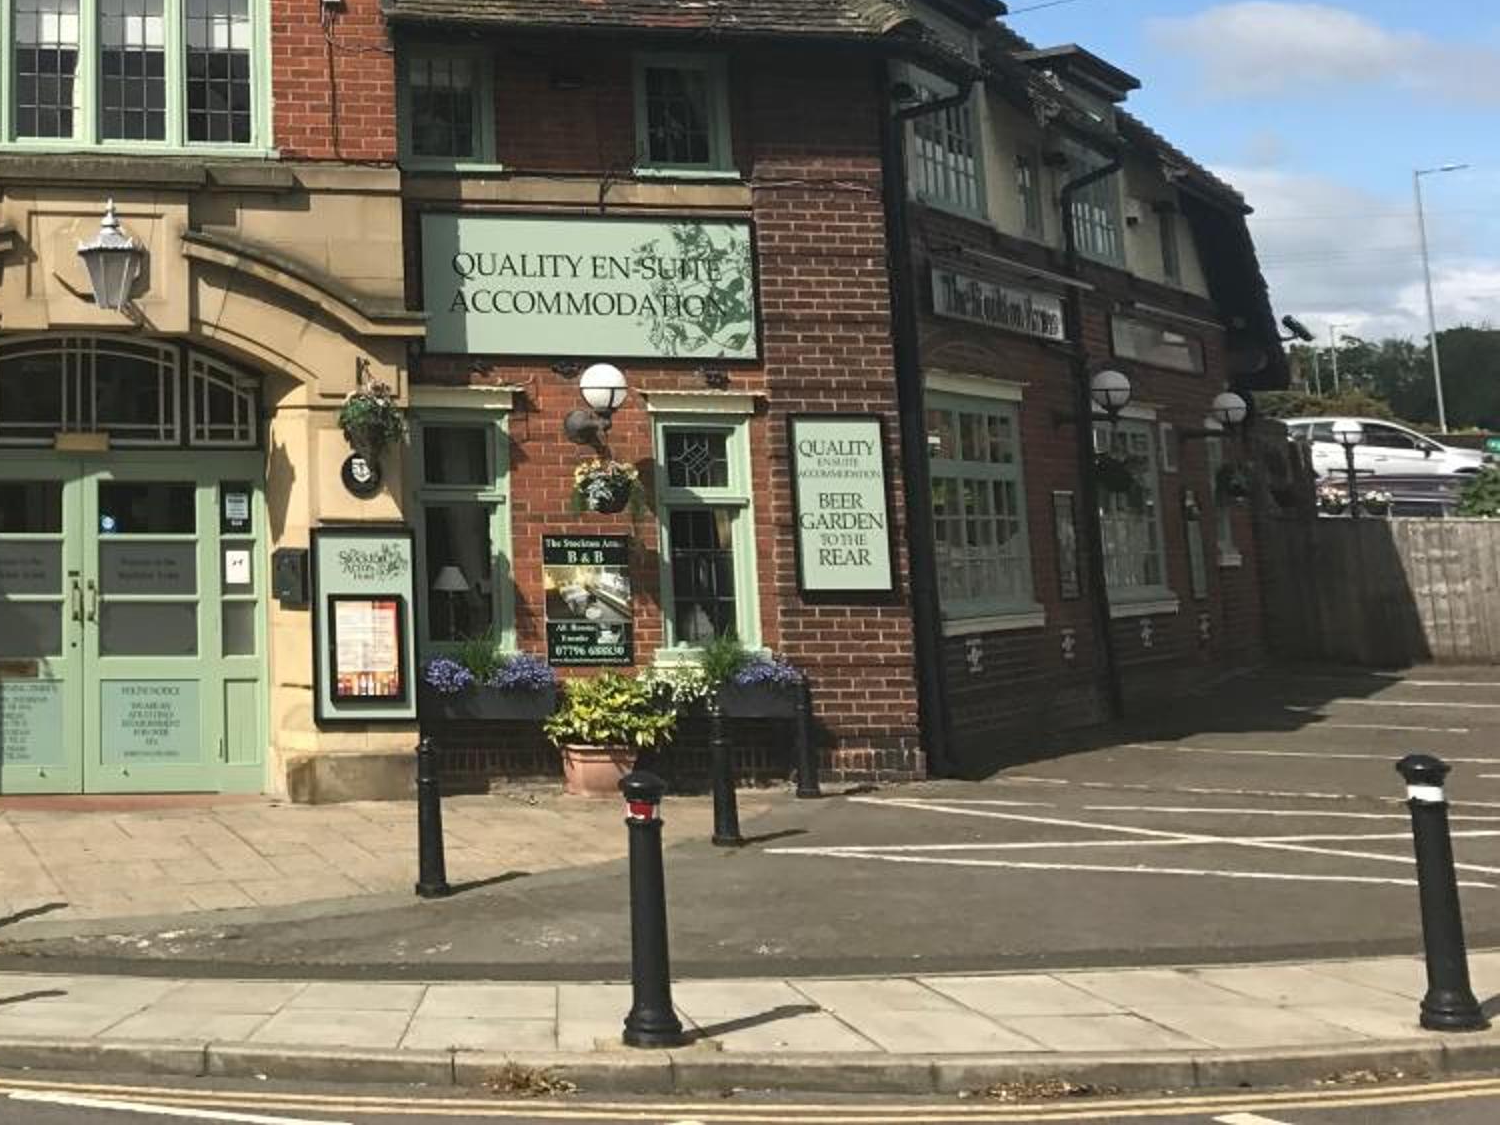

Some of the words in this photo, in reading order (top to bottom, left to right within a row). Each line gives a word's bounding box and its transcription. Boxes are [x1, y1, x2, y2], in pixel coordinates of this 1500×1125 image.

[453, 251, 583, 280] QUALITY
[592, 255, 723, 282] EN-SUITE
[449, 289, 729, 318] ACCOMMODATION
[798, 439, 875, 458] QUALITY
[818, 492, 864, 509] BEER
[799, 512, 885, 530] GARDEN
[545, 538, 561, 548] The
[563, 538, 600, 548] Stockton
[820, 533, 838, 546] TO
[840, 533, 867, 546] THE
[567, 550, 577, 563] B
[581, 552, 590, 563] &
[594, 550, 604, 563] B
[818, 548, 873, 566] REAR
